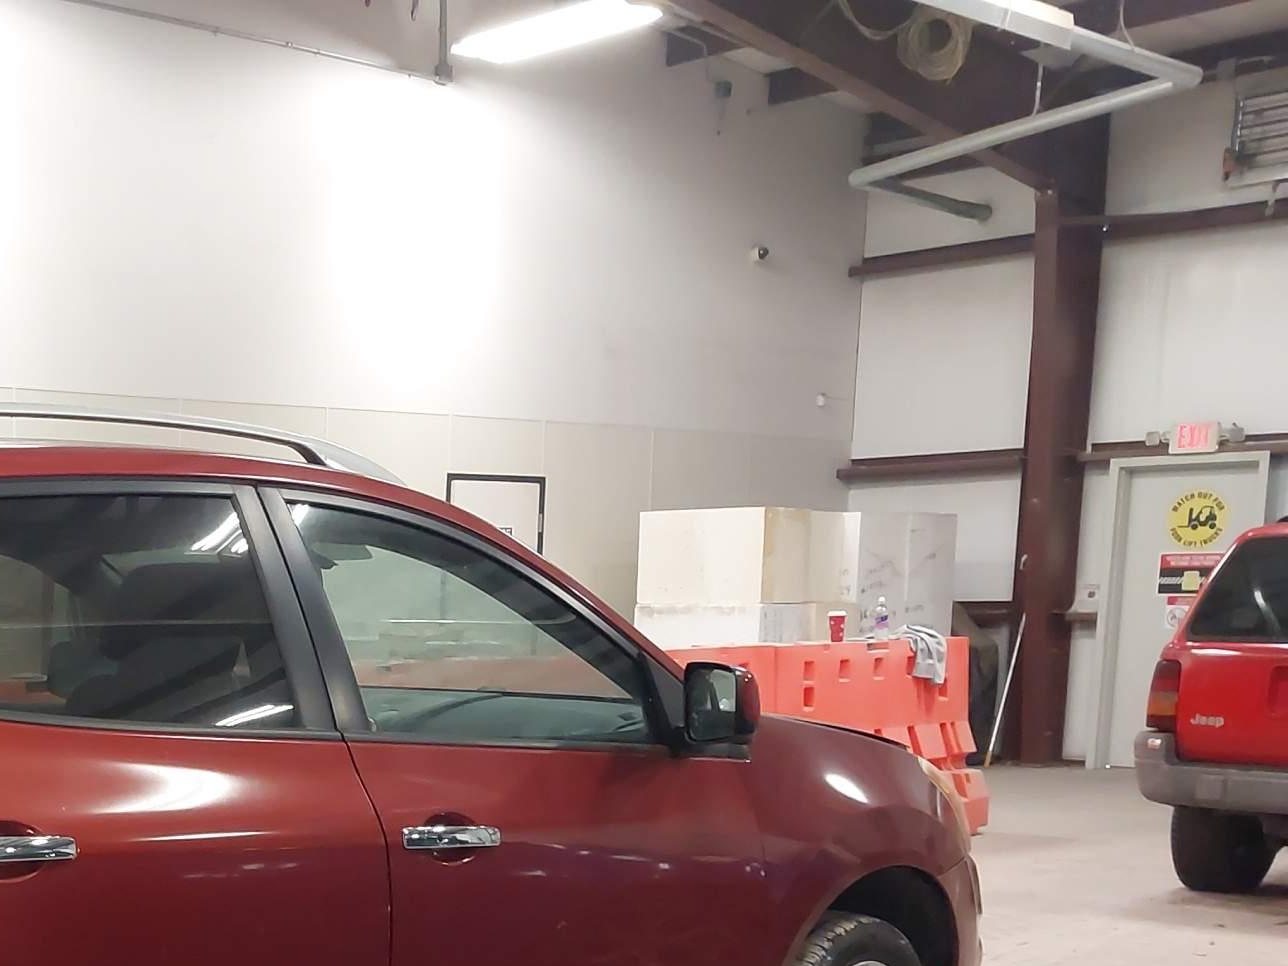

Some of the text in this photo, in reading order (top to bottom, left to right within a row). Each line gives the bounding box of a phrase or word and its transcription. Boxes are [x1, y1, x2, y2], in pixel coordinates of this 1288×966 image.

[1176, 423, 1209, 449] EXIT
[1172, 491, 1225, 512] WATCH OUT FOR
[1190, 713, 1225, 728] Jeep
